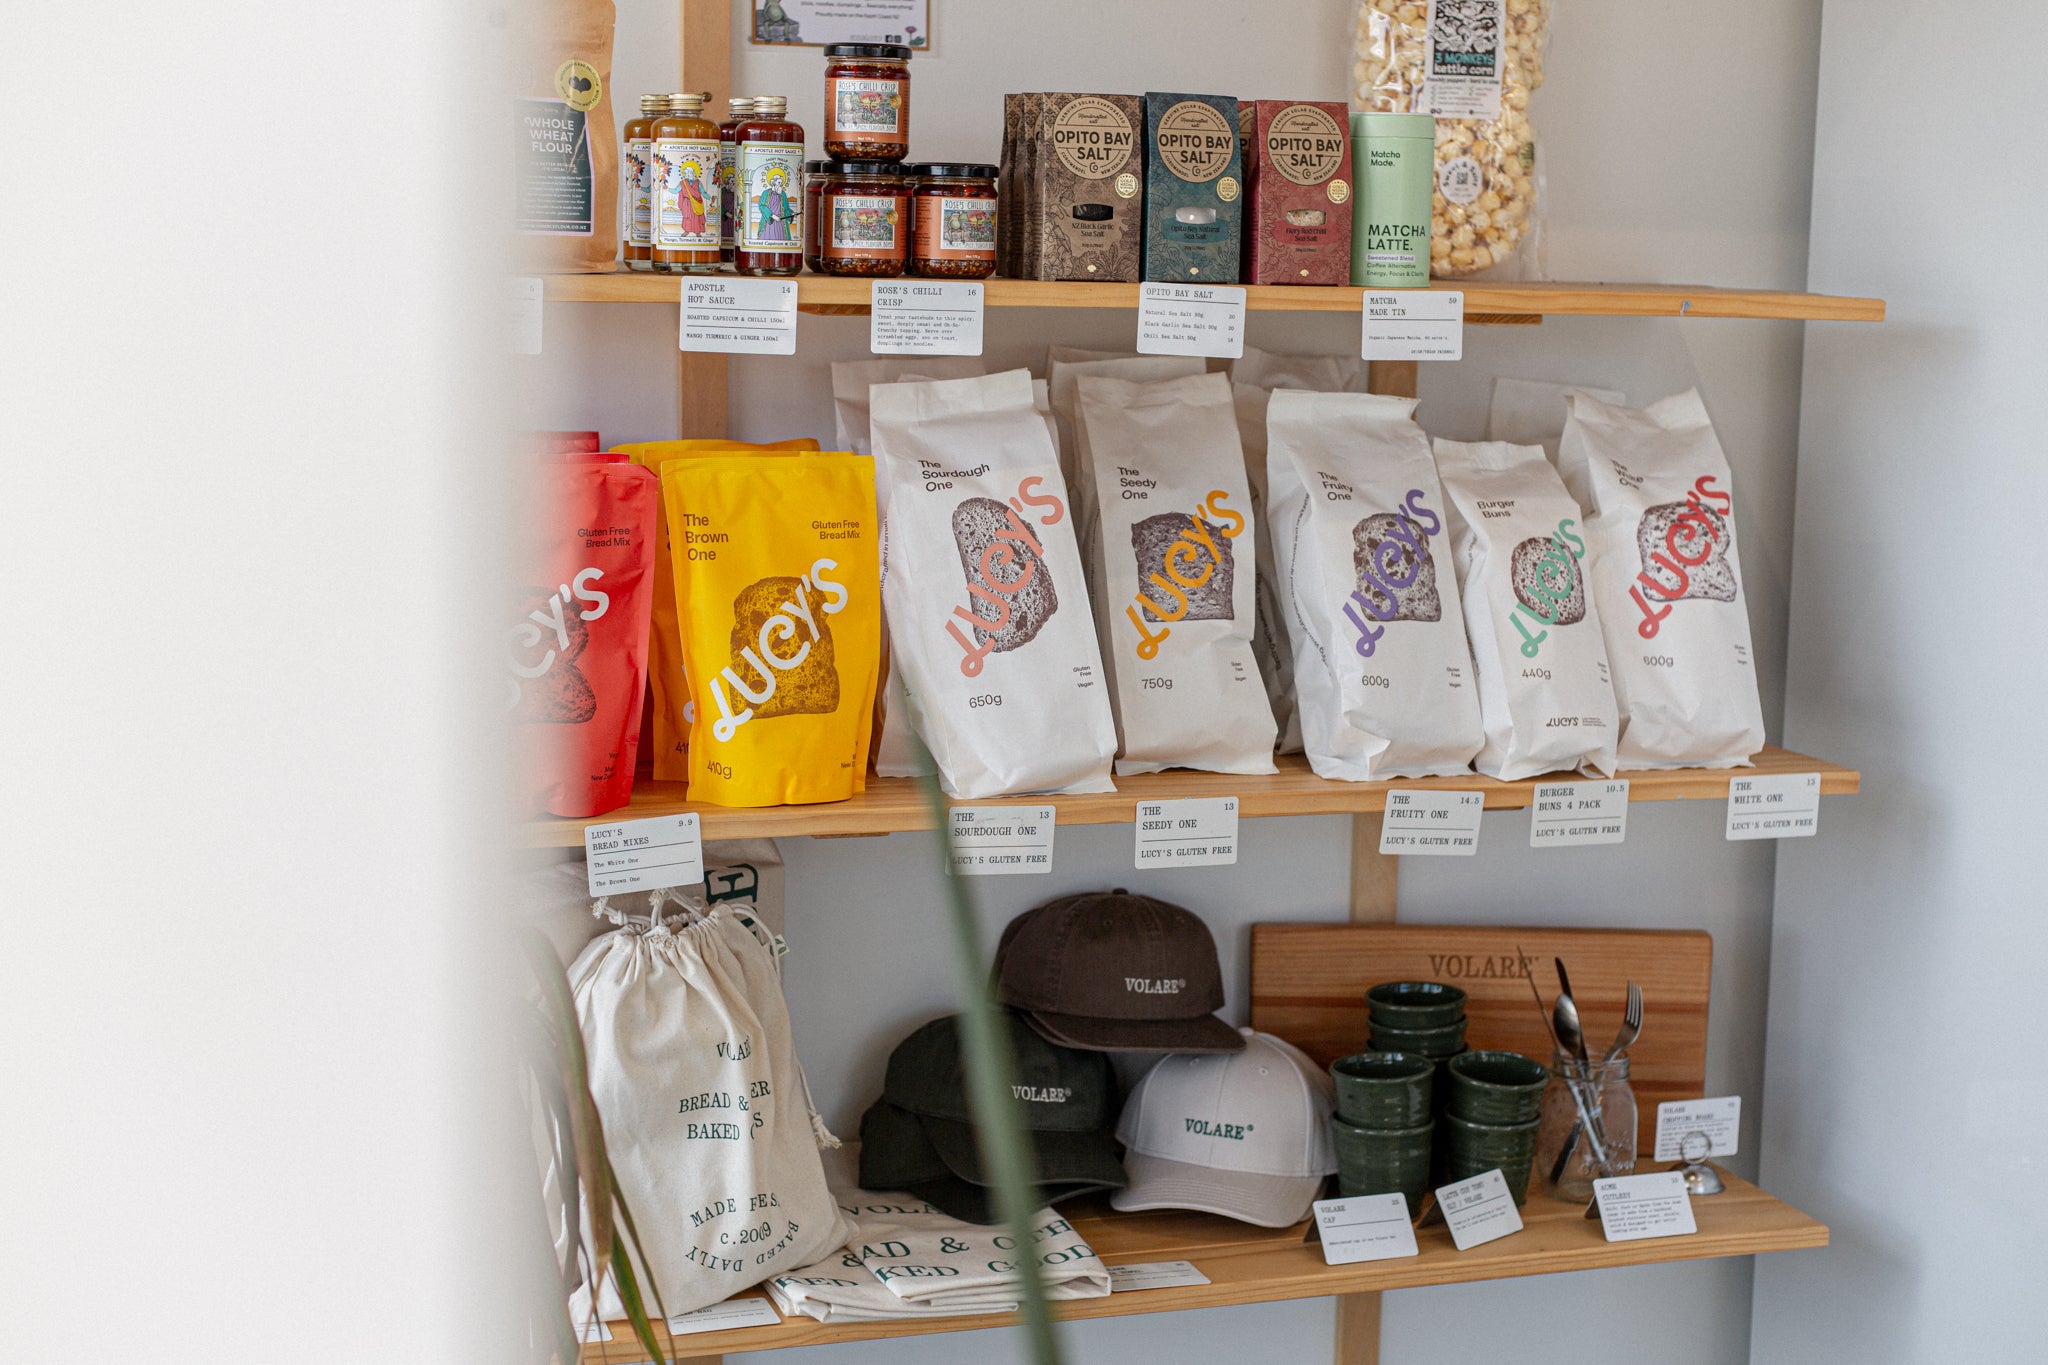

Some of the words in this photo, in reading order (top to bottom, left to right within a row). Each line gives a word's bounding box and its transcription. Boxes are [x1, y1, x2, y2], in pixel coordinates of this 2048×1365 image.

[1435, 53, 1443, 64] 3
[1444, 53, 1495, 66] MONKEYS
[1435, 63, 1467, 75] kettle
[1469, 65, 1494, 75] corn
[858, 82, 878, 91] CHILLI
[880, 82, 896, 92] CRISP
[529, 118, 574, 131] WHOLE
[529, 130, 574, 142] WHEAT
[1054, 130, 1100, 145] OPITO
[1104, 131, 1132, 146] BAY
[1159, 134, 1201, 148] OPITO
[1205, 136, 1232, 149] BAY
[532, 142, 573, 154] FLOUR
[1269, 138, 1312, 151] OPITO
[1316, 138, 1342, 152] BAY
[1077, 147, 1113, 160] SALT
[1180, 150, 1214, 164] SALT
[1371, 150, 1401, 158] Matcha
[1291, 154, 1324, 167] SALT
[1368, 224, 1426, 237] MATCHA
[1368, 238, 1413, 251] LATTE.
[688, 284, 725, 292] APOSTLE
[878, 287, 908, 295] ROSE'S
[913, 288, 943, 296] CHILLI
[1146, 288, 1171, 296] OPITO
[1194, 290, 1214, 298] SALT
[687, 295, 704, 304] HOT
[709, 296, 736, 305] SAUCE
[877, 298, 903, 306] CRISP
[1370, 297, 1397, 305] MATCHA
[1369, 308, 1388, 316] MADE
[918, 459, 942, 469] The
[922, 463, 990, 480] Sourdough
[1117, 467, 1140, 476] The
[1318, 471, 1339, 482] The
[926, 480, 953, 492] One
[1120, 477, 1157, 489] Seedy
[1322, 481, 1353, 493] Fruity
[1122, 490, 1148, 500] One
[1327, 491, 1352, 501] One
[1477, 500, 1515, 511] Burger
[1482, 510, 1511, 518] Buns
[684, 514, 709, 527] The
[812, 520, 842, 530] Gluten
[843, 519, 860, 528] Free
[577, 527, 608, 538] Gluten
[609, 526, 630, 536] Free
[685, 530, 729, 544] Brown
[819, 531, 846, 540] Bread
[847, 530, 861, 539] Mix
[585, 538, 612, 548] Bread
[613, 538, 630, 547] Mix
[687, 548, 717, 561] One
[1643, 655, 1674, 667] 600g
[1521, 668, 1551, 680] 440g
[1141, 678, 1173, 690] 750g
[1361, 676, 1390, 688] 600g
[969, 694, 1003, 709] 650g
[707, 760, 732, 779] 410g
[1540, 788, 1574, 797] BURGER
[1606, 785, 1625, 793] 10.5
[1736, 782, 1752, 791] THE
[1392, 795, 1410, 804] THE
[1734, 795, 1762, 804] WHITE
[1767, 794, 1783, 803] ONE
[1142, 807, 1161, 816] THE
[1538, 802, 1562, 811] BUNS
[1567, 801, 1573, 809] 4
[1578, 800, 1602, 809] PACK
[955, 813, 975, 822] THE
[1039, 811, 1050, 819] 13
[1390, 810, 1426, 818] FRUITY
[1430, 810, 1449, 819] ONE
[591, 829, 623, 840] LUCY'S
[678, 819, 693, 827] 9.9
[1142, 820, 1173, 830] SEEDY
[1178, 819, 1197, 828] ONE
[1732, 822, 1760, 830] LUCY'S
[1763, 820, 1791, 829] GLUTEN
[1795, 818, 1813, 827] FREE
[954, 827, 1012, 836] SOURDOUGH
[1017, 826, 1037, 835] ONE
[1536, 828, 1565, 837] LUCY'S
[1569, 827, 1598, 835] GLUTEN
[1602, 825, 1621, 833] FREE
[592, 841, 619, 851] BREAD
[623, 837, 650, 846] MIXES
[1419, 837, 1449, 845] GLUTEN
[1141, 849, 1172, 858] LUCY'S
[1176, 847, 1208, 857] GLUTEN
[1211, 846, 1232, 855] FREE
[953, 856, 984, 865] LUCY'S
[989, 855, 1021, 864] GLUTEN
[1026, 855, 1047, 863] FREE
[678, 1092, 731, 1114] BREAD
[738, 1095, 749, 1111] &
[687, 1123, 740, 1140] BAKED
[690, 1198, 736, 1228] MADE
[756, 1220, 799, 1265] BAKED
[685, 1245, 743, 1272] DAILY
